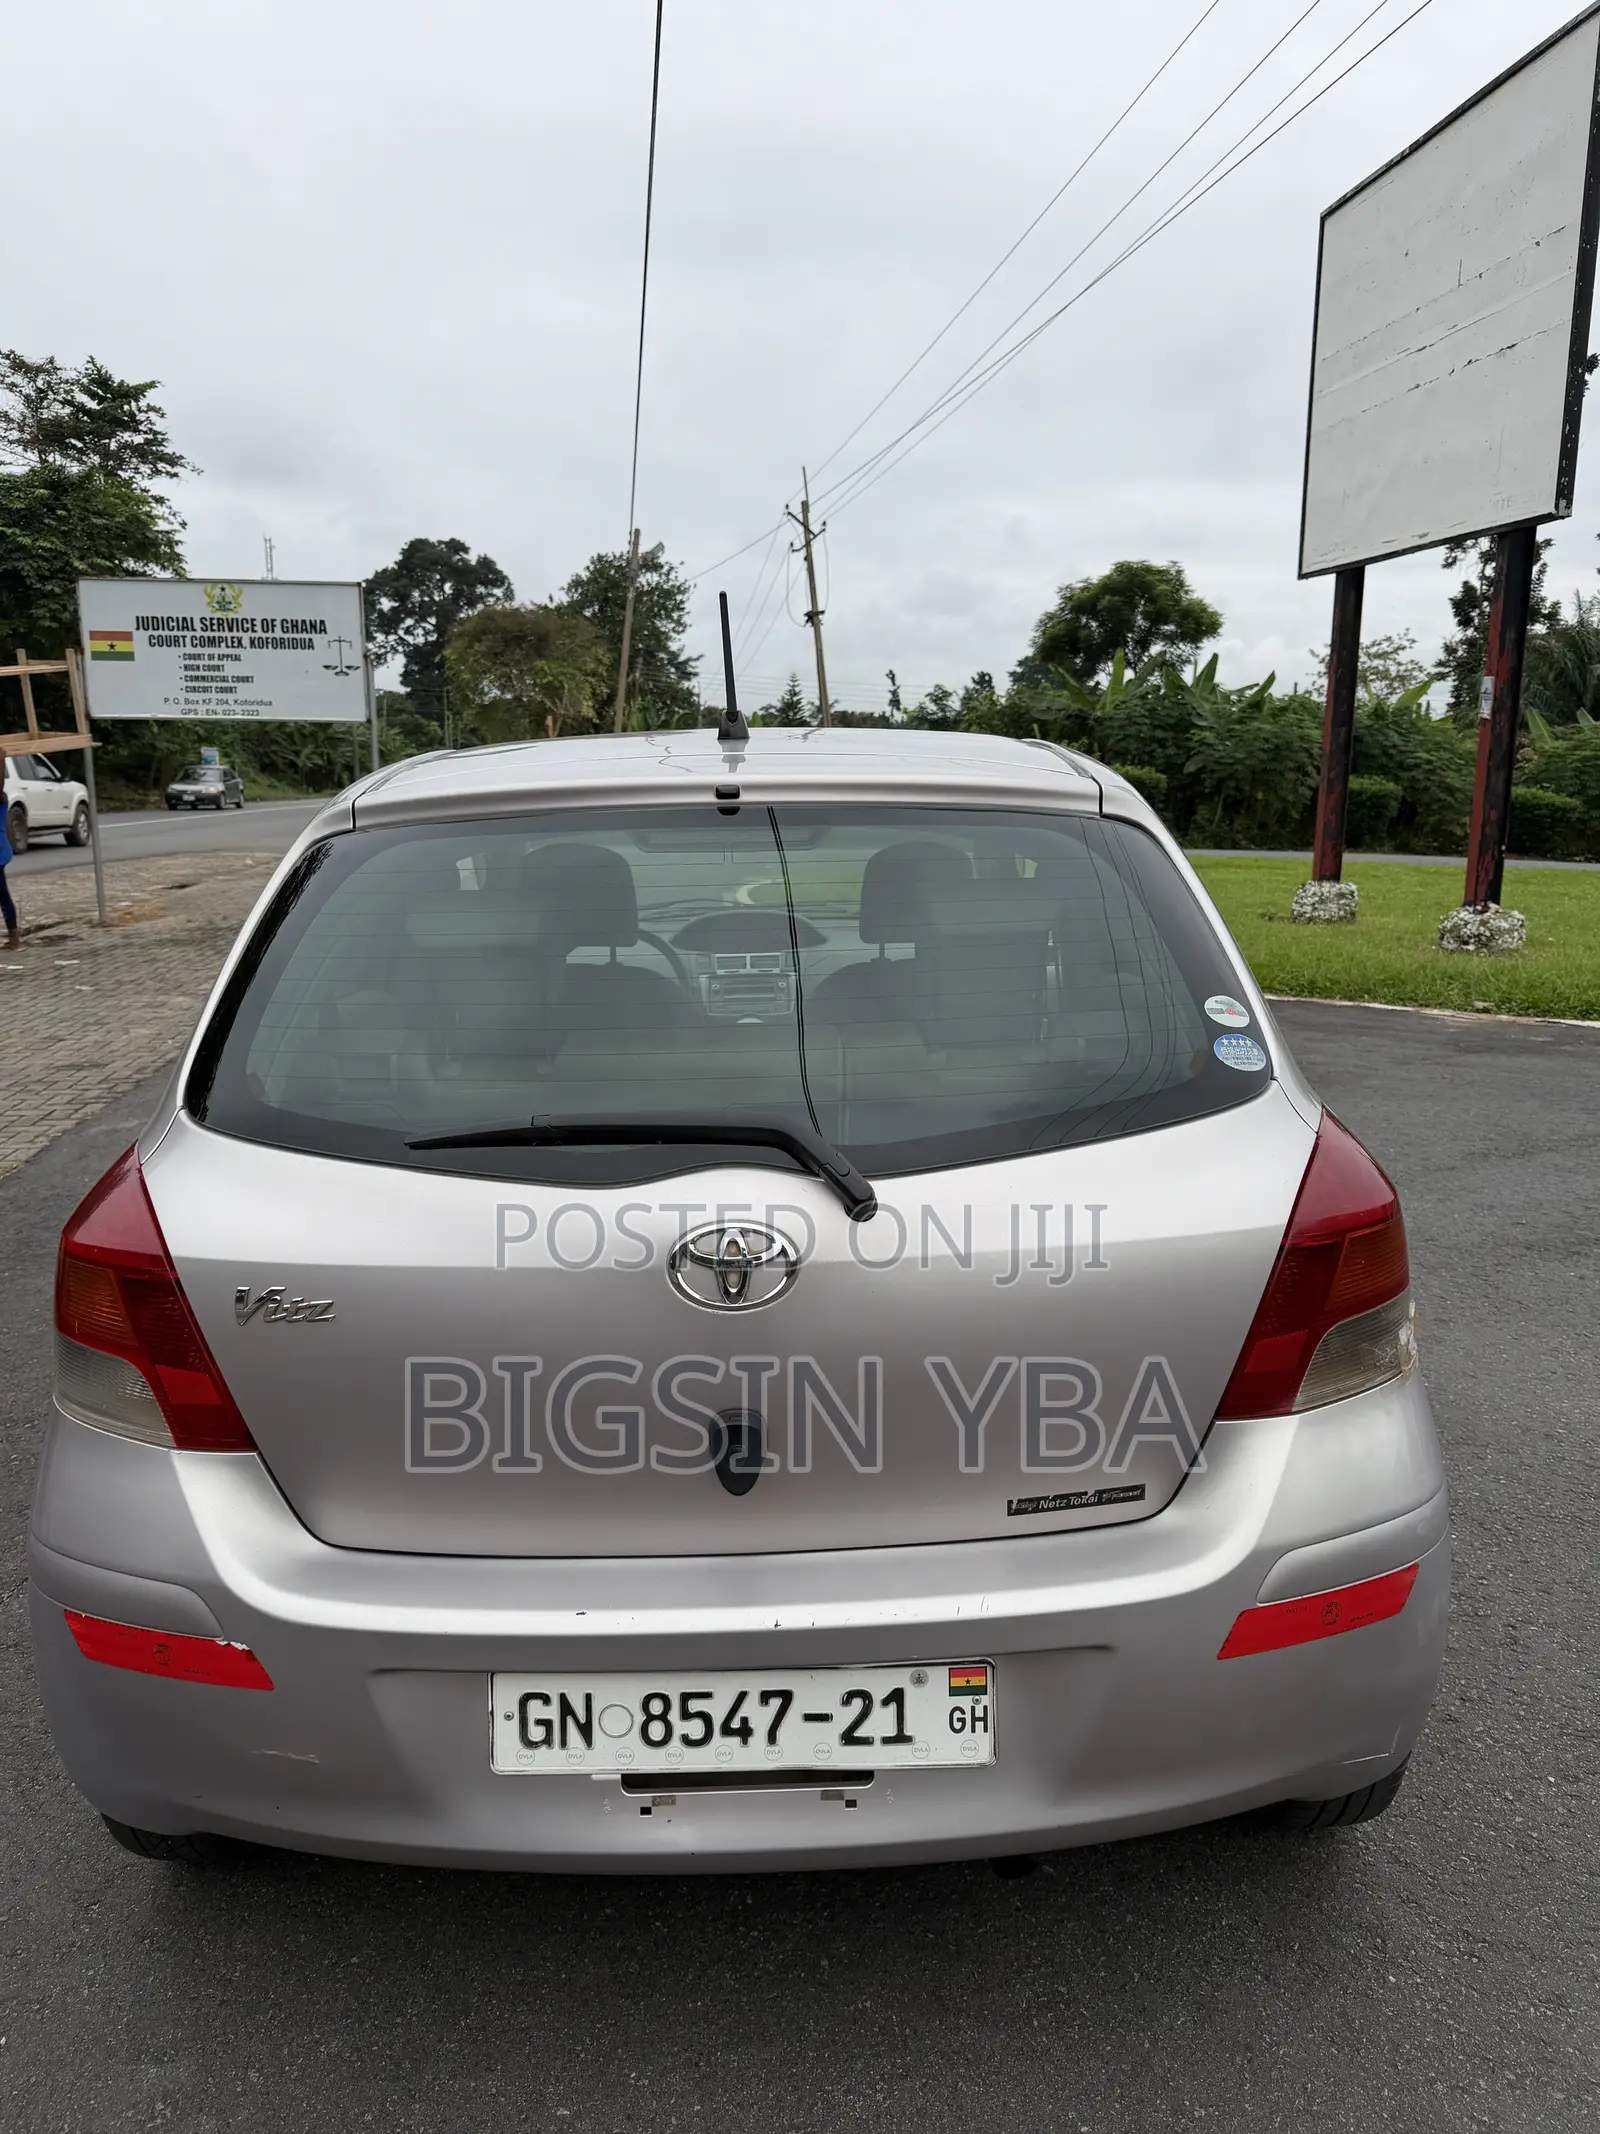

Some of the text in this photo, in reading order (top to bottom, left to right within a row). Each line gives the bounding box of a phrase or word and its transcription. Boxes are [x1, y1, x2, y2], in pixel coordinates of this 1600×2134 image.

[135, 615, 328, 635] JUDICIAL SERVICE OF GHANA
[148, 634, 315, 651] COURT COMPLEX, KOFORIDUA
[182, 653, 242, 662] COURT OF APPEAL
[183, 664, 225, 672] HIGH COURT
[184, 674, 255, 684] COMMERCIAL COURT
[185, 685, 238, 694] CIRCUIT COURT
[184, 698, 200, 706] Box
[234, 1286, 337, 1327] Vitz
[1038, 1499, 1067, 1509] Netz
[1069, 1493, 1099, 1506] Tokai
[518, 1686, 915, 1750] GN 8547-21
[949, 1705, 988, 1734] GH
